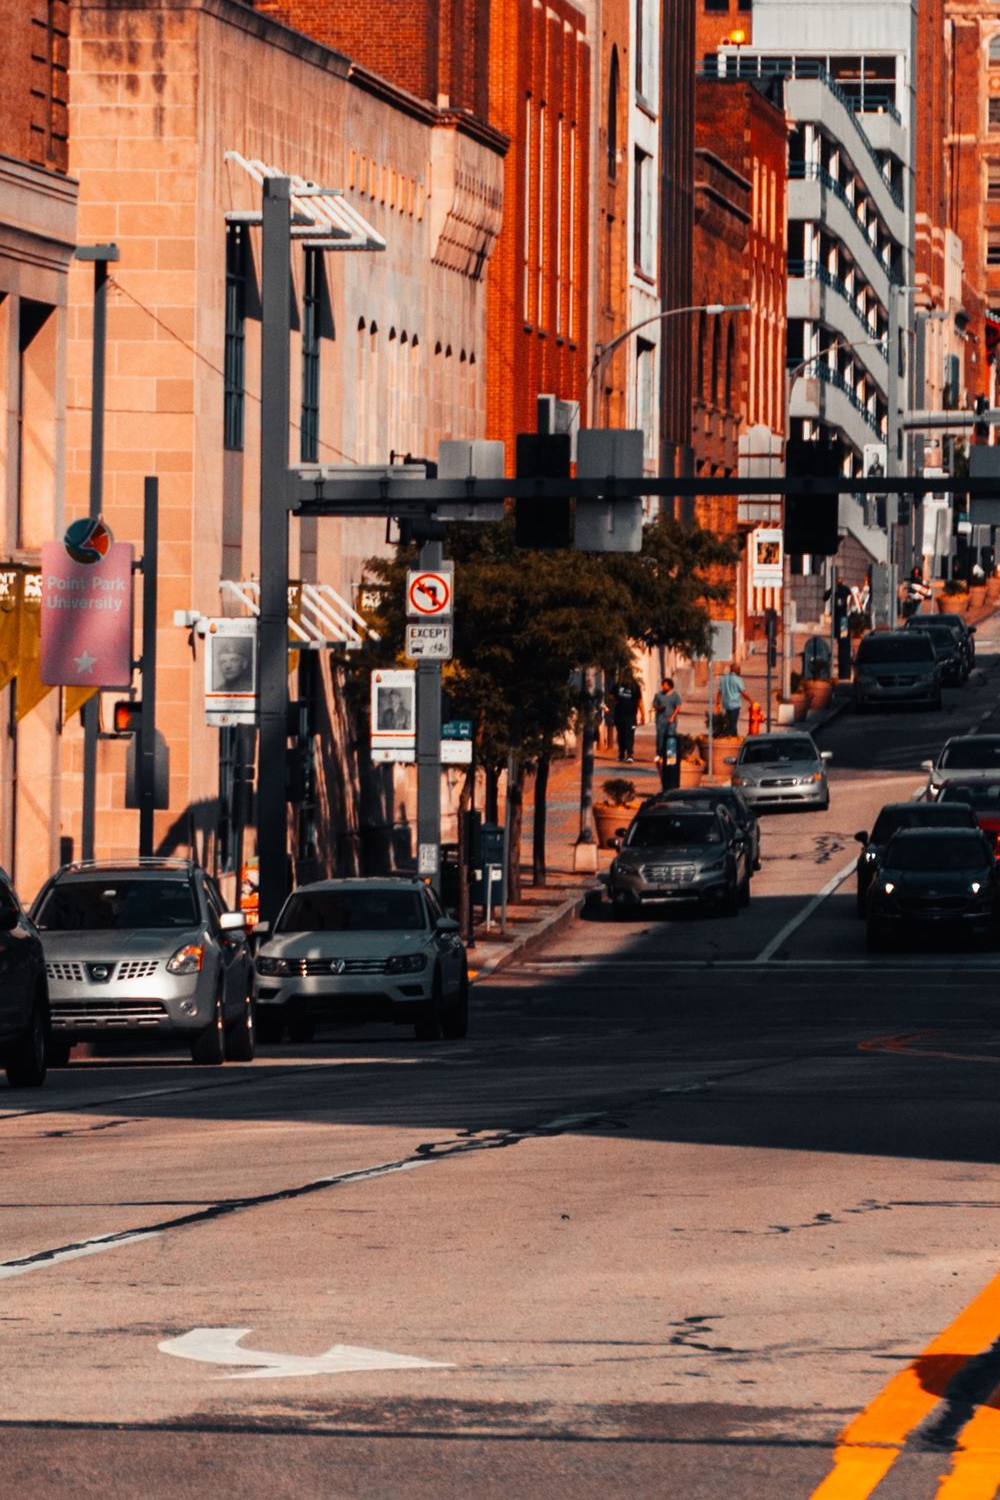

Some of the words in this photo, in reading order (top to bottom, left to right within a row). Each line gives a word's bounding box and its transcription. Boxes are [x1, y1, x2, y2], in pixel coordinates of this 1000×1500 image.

[46, 576, 87, 591] Point
[92, 576, 125, 590] Park
[24, 585, 43, 597] PA
[46, 595, 123, 612] University
[411, 628, 448, 639] EXCEPT
